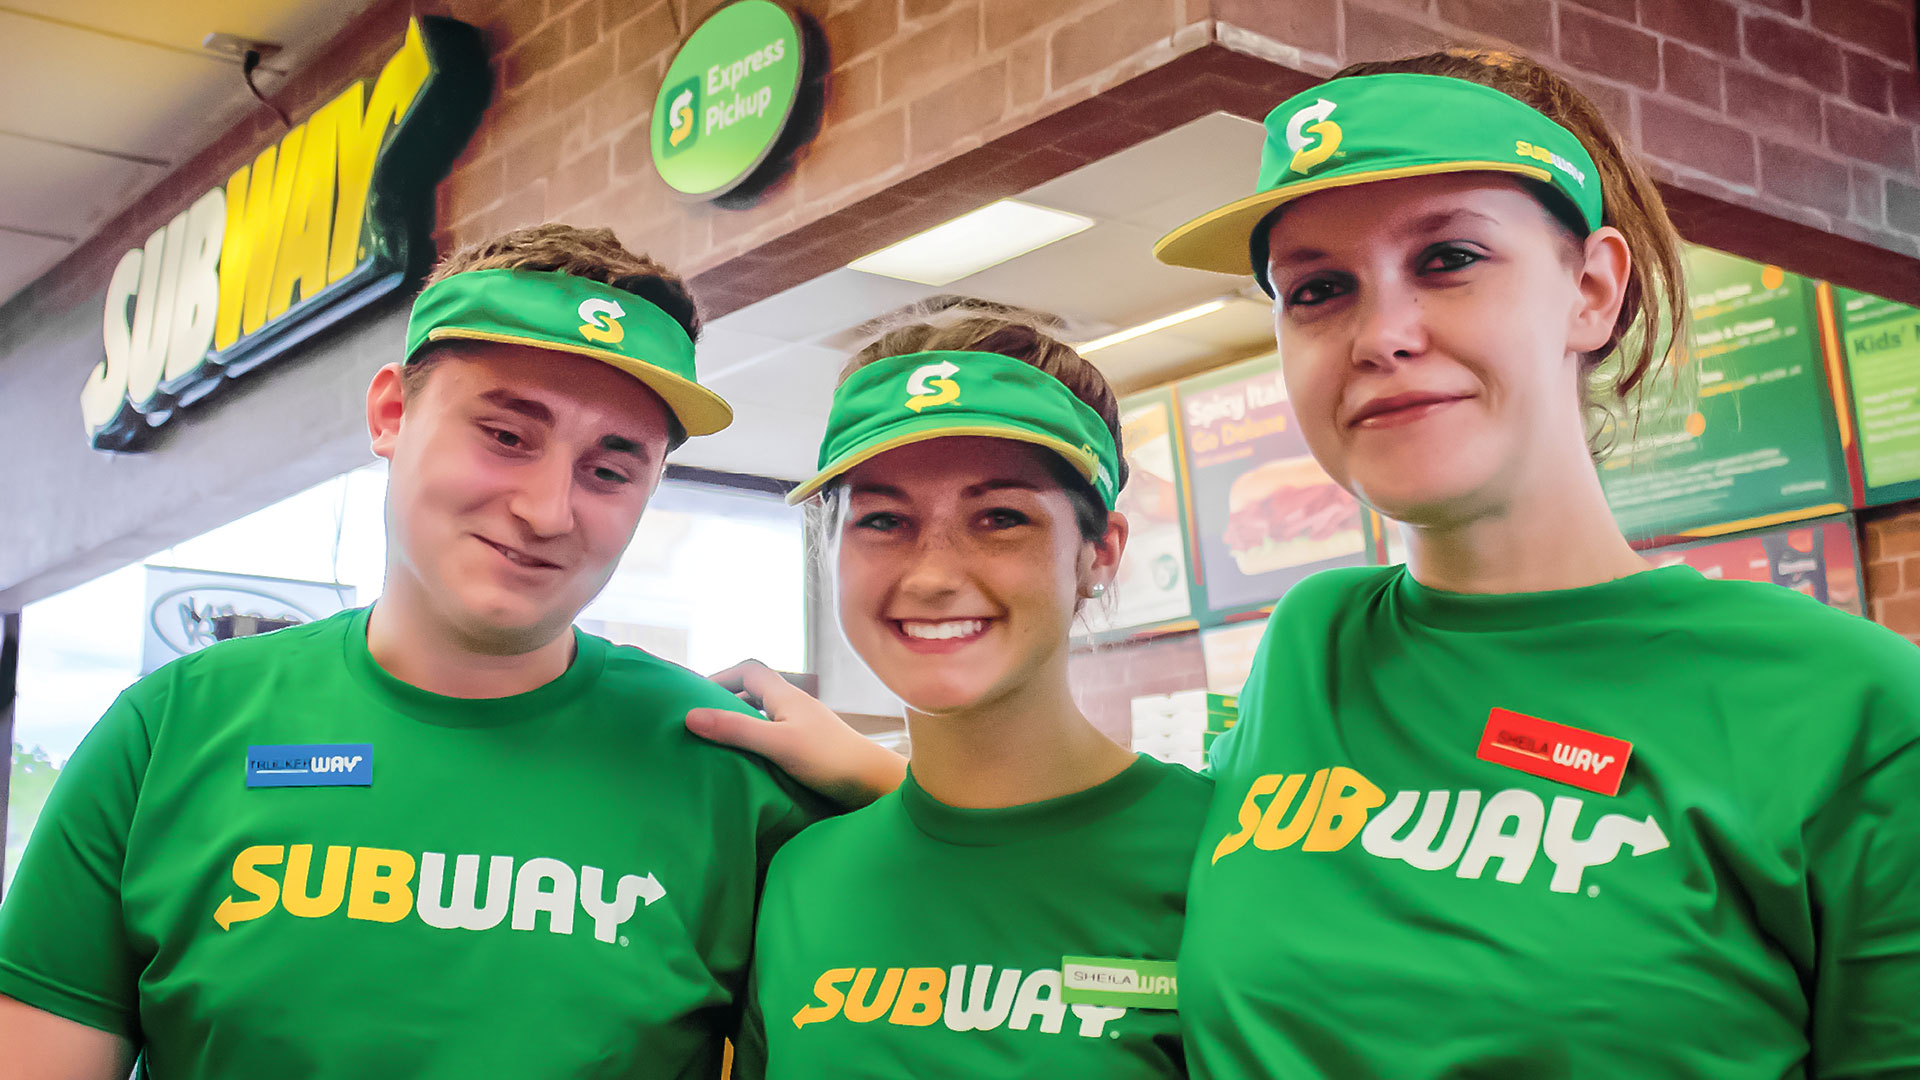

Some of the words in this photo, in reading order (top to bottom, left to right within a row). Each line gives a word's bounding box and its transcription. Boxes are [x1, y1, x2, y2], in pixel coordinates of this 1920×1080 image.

[707, 38, 785, 96] Express
[705, 85, 772, 136] Pickup
[80, 16, 431, 434] SUBWAY
[311, 755, 363, 773] WAY
[1552, 742, 1616, 775] WAY
[1212, 766, 1670, 894] SUBWAY
[213, 844, 667, 944] SUBWAY
[1073, 970, 1132, 985] SHEILA
